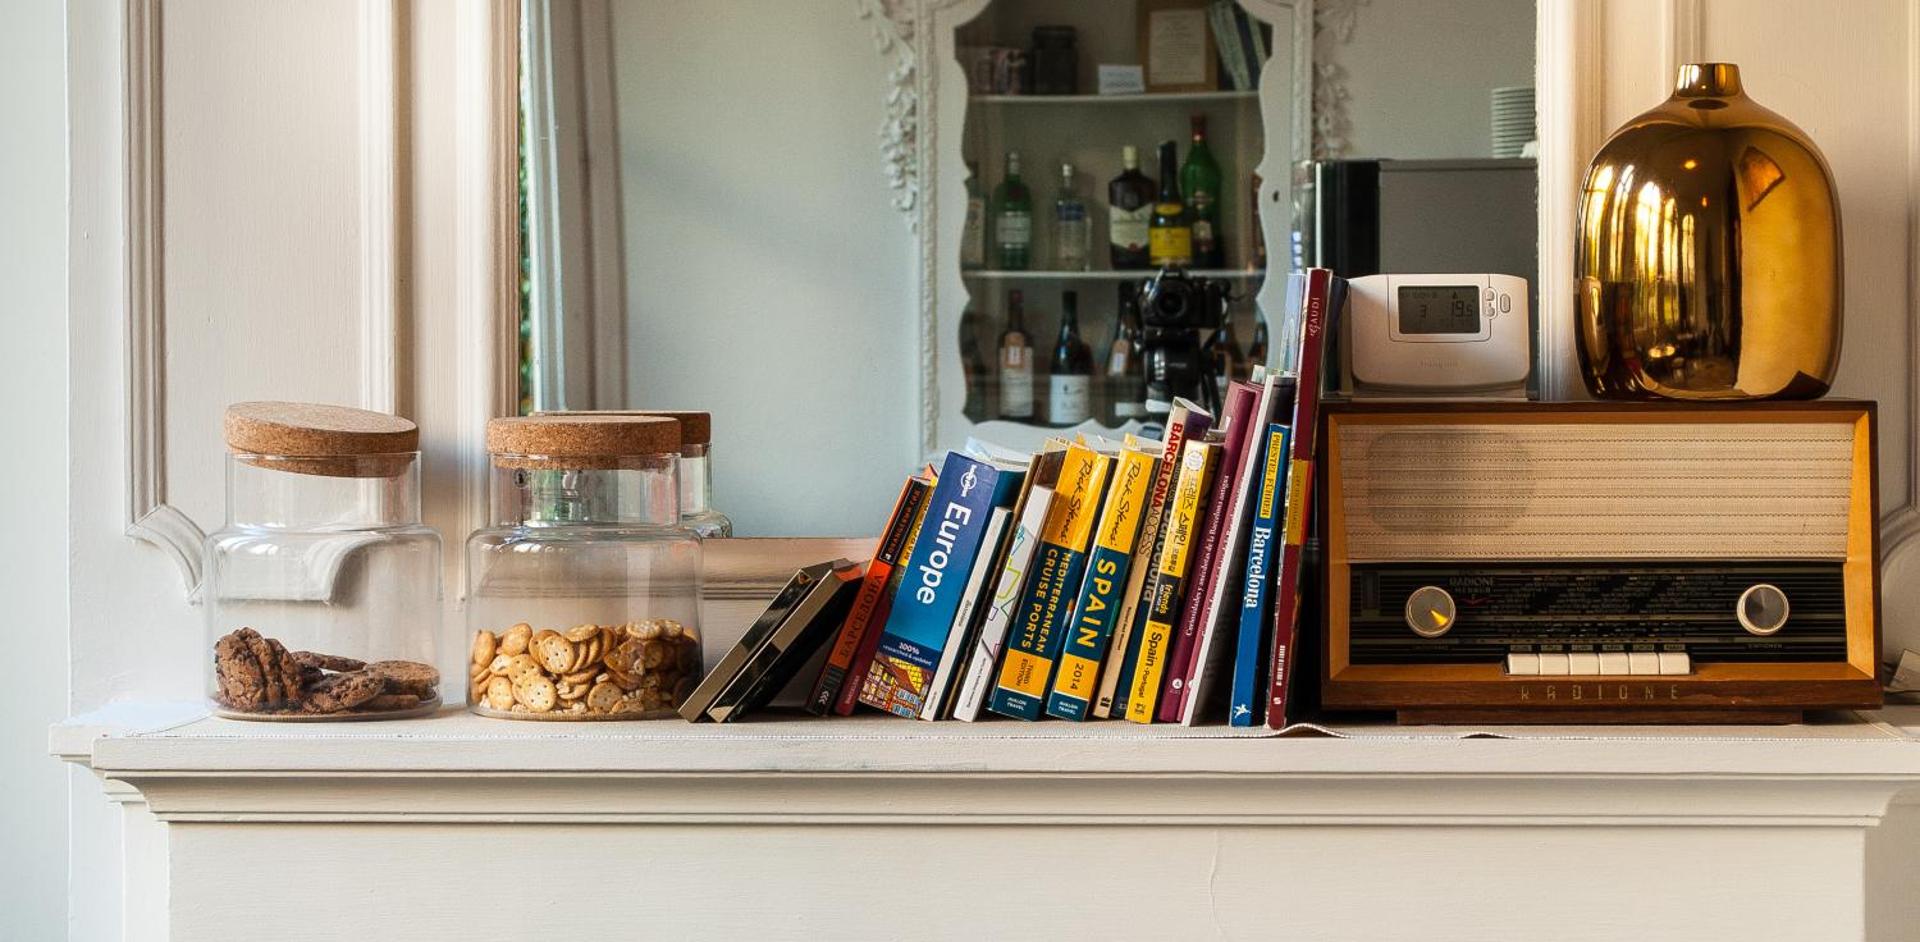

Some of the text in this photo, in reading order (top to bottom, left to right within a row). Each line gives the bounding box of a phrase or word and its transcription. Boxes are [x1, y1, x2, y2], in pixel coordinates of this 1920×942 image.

[1074, 458, 1093, 494] Rick
[1125, 461, 1141, 497] Rick
[1152, 422, 1184, 508] BARCELONA
[916, 502, 972, 604] Europe
[1244, 527, 1272, 608] Barcelona
[1022, 549, 1058, 648] CRUISE PORTS
[1036, 552, 1071, 652] MEDITERRANEAN
[1076, 559, 1116, 648] SPAIN
[1159, 584, 1173, 614] friends
[1070, 662, 1084, 690] 2014
[1146, 631, 1162, 667] Spain
[1521, 685, 1679, 700] RADIONE
